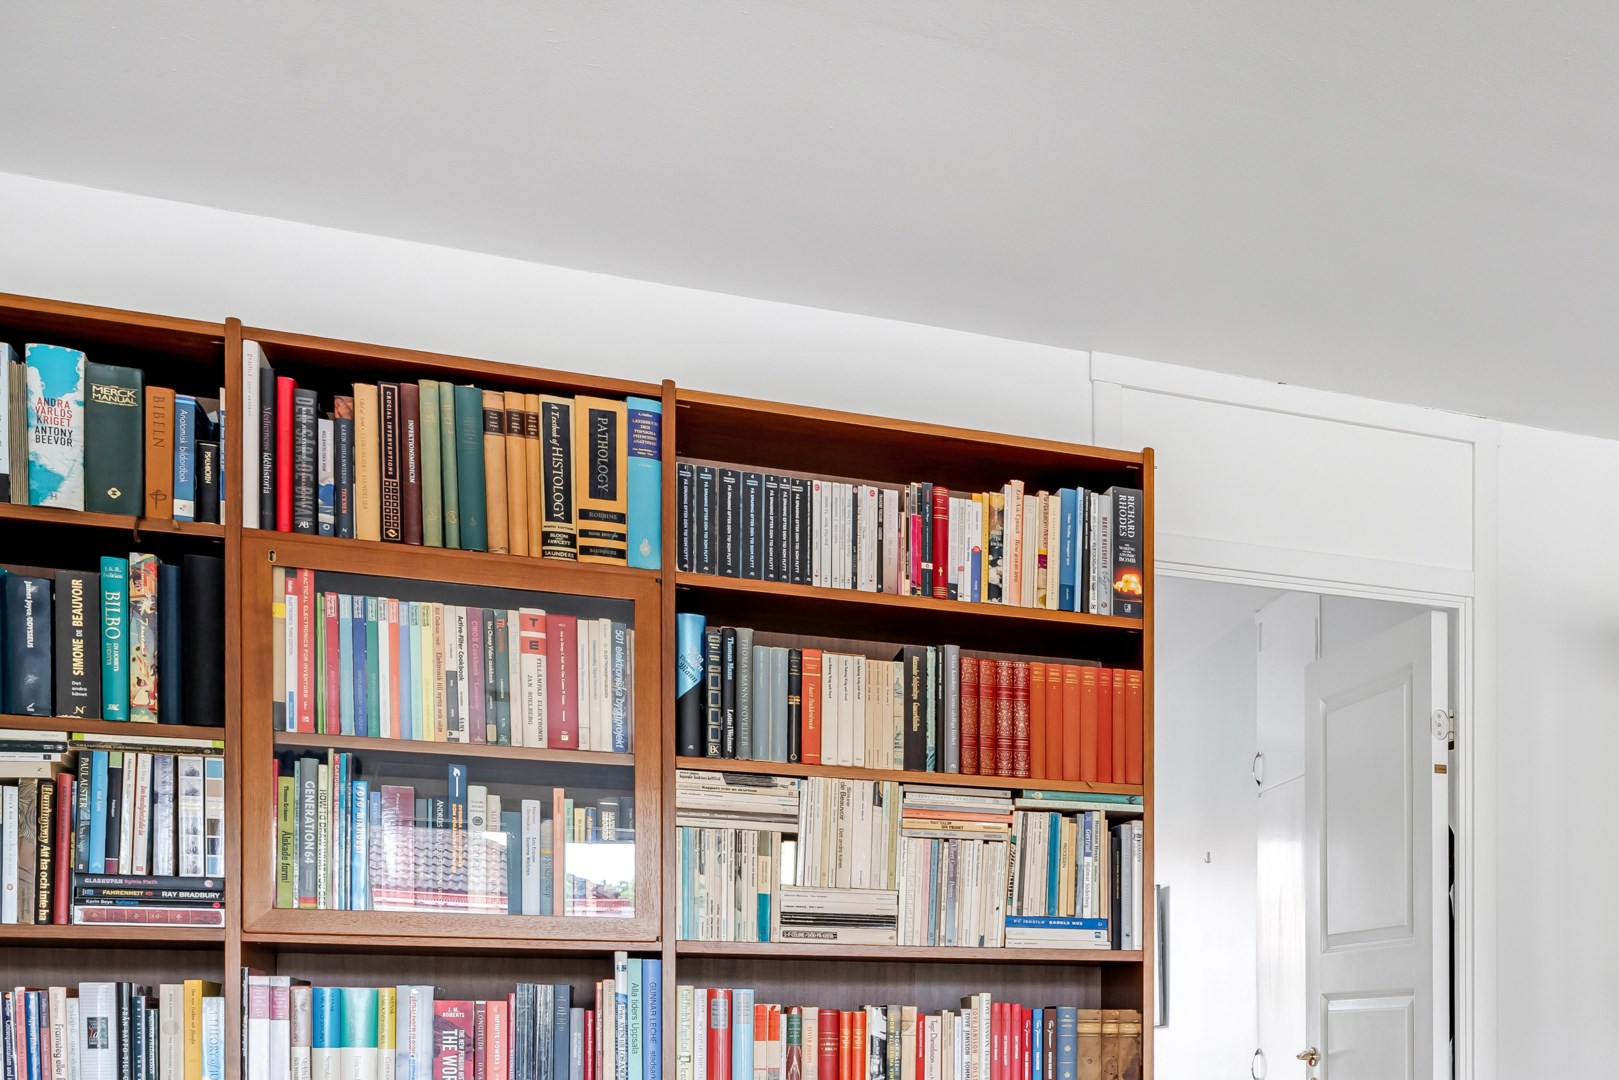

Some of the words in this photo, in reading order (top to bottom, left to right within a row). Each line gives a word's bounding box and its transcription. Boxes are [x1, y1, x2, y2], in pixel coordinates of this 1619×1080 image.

[36, 397, 70, 410] ANDRA
[91, 385, 136, 398] MERCK
[91, 392, 136, 405] MANUAL
[34, 426, 73, 438] ANTONY
[36, 416, 71, 428] KRIGET
[152, 395, 165, 449] BIBELN
[179, 409, 188, 444] Anatomisk
[35, 435, 73, 447] BEEVOR
[179, 446, 188, 483] bildordbok
[597, 417, 609, 493] PATHOLOGY
[1118, 494, 1127, 537] RHODES
[1127, 495, 1135, 539] RICHARD
[549, 532, 569, 540] BLOOM
[23, 580, 33, 599] James
[71, 579, 83, 627] BEAUVOIR
[104, 590, 121, 640] BILBO
[26, 616, 34, 649] ODYSSEUS
[76, 629, 83, 637] DE
[614, 629, 625, 649] 501
[72, 638, 84, 676] SIMONE
[727, 636, 735, 663] Thomas
[614, 650, 626, 699] elektroniska
[613, 699, 627, 749] byggprojekt
[726, 708, 734, 725] Lotte
[726, 729, 734, 753] Weimar
[80, 756, 90, 779] PAUL
[79, 778, 89, 809] AUSTER
[37, 784, 53, 844] Hemingway
[304, 780, 316, 852] GENERATION
[40, 844, 49, 858] Att
[1084, 828, 1092, 853] Gertrud
[40, 858, 49, 871] ha
[304, 852, 315, 865] 64
[39, 871, 49, 889] och
[38, 890, 48, 909] inte
[102, 889, 144, 897] FAHRENHEIT
[161, 890, 178, 898] RAY
[178, 891, 221, 899] BRADBURY
[38, 909, 48, 921] ha
[631, 982, 640, 999] Alla
[649, 981, 657, 1018] GUNNAR
[632, 1001, 640, 1021] tiders
[53, 1023, 64, 1059] Framsteg
[209, 1017, 219, 1059] THEORY
[442, 1028, 458, 1052] THE
[458, 1029, 466, 1038] THE
[477, 1009, 485, 1051] LONGITUDE
[630, 1023, 639, 1055] Uppsala
[649, 1020, 657, 1045] LECHE
[971, 1026, 979, 1054] JANSSON
[4, 1019, 13, 1066] Consequentialism
[457, 1038, 466, 1050] NEW
[963, 1030, 971, 1056] JANSSON
[55, 1059, 65, 1076] eller
[209, 1059, 219, 1069] of
[457, 1050, 466, 1071] PENGUIN
